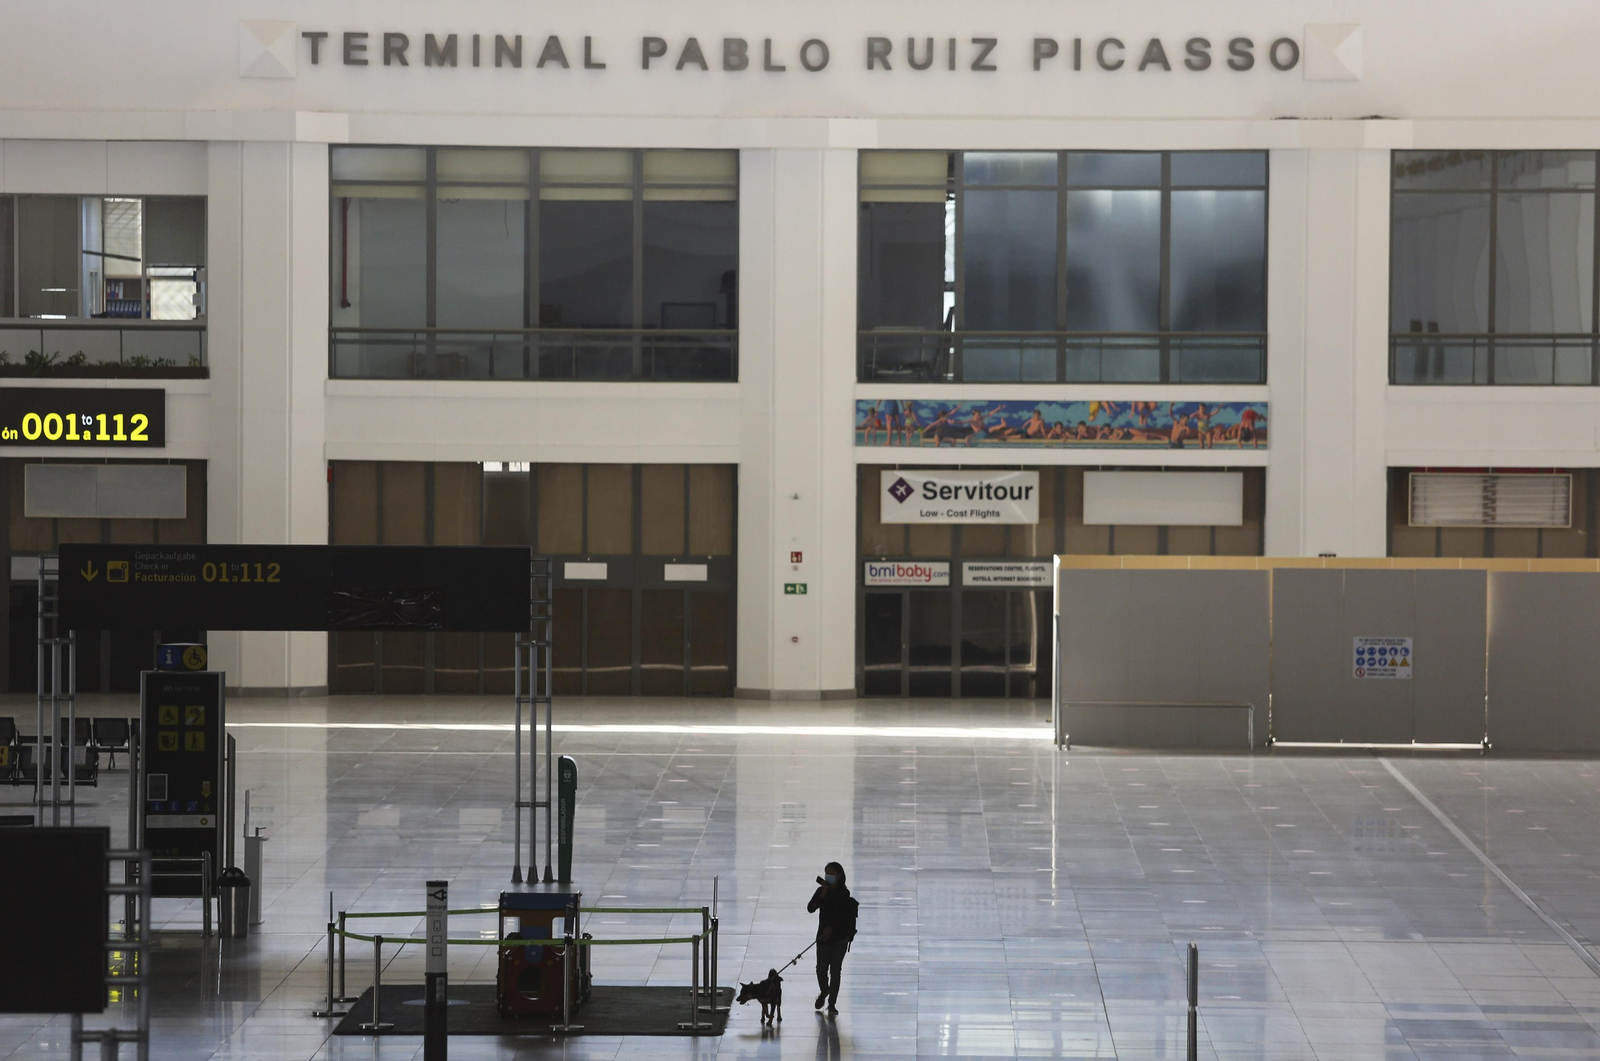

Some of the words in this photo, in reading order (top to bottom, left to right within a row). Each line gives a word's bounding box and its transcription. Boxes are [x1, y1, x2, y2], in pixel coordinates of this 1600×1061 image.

[301, 31, 606, 69] TERMINAL
[641, 36, 830, 72] PABLO
[866, 37, 998, 71] RUIZ
[1032, 37, 1300, 72] PICASSO
[81, 414, 93, 425] to
[22, 412, 80, 441] 001
[96, 413, 149, 441] 112
[82, 430, 91, 441] a
[922, 481, 1034, 501] Servitour
[920, 509, 938, 518] Low
[946, 509, 968, 518] Cost
[970, 509, 1001, 519] Flights
[134, 551, 196, 561] Gepackaufgabe
[134, 562, 169, 570] Check-in
[231, 563, 240, 571] to
[134, 572, 196, 582] Facturación
[202, 562, 230, 583] 01
[240, 562, 281, 583] 112
[232, 575, 238, 583] a
